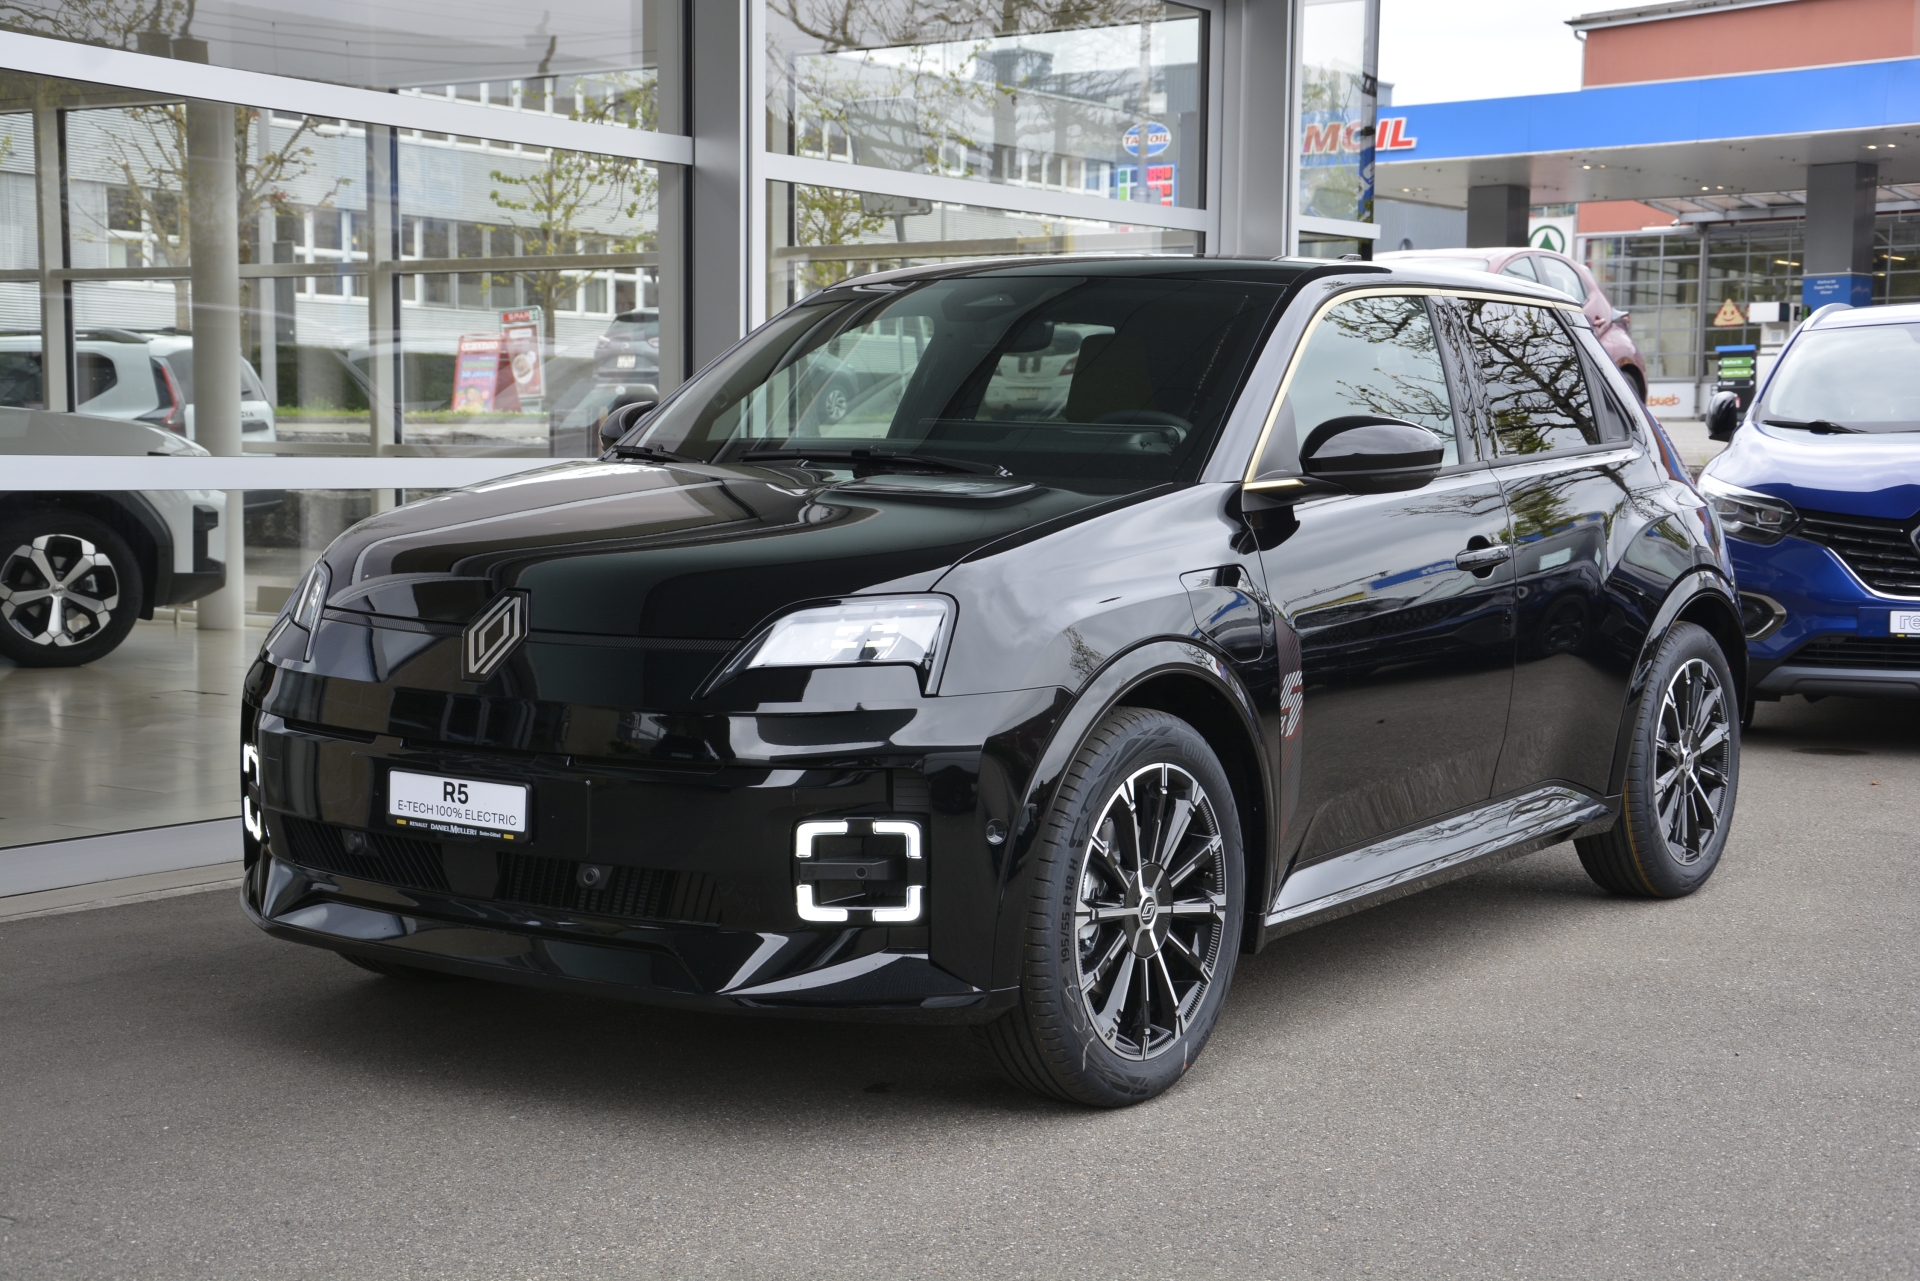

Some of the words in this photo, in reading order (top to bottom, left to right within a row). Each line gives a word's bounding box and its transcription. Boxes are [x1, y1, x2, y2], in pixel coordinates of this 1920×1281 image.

[1124, 134, 1170, 146] TAOIL
[443, 781, 469, 804] R5
[398, 800, 434, 815] E-TECH
[436, 805, 462, 819] 100%
[465, 809, 517, 826] ELECTRIC
[409, 820, 428, 828] RENAULT
[1065, 875, 1075, 890] 18
[1063, 896, 1072, 906] R
[1061, 912, 1070, 964] 195/55
